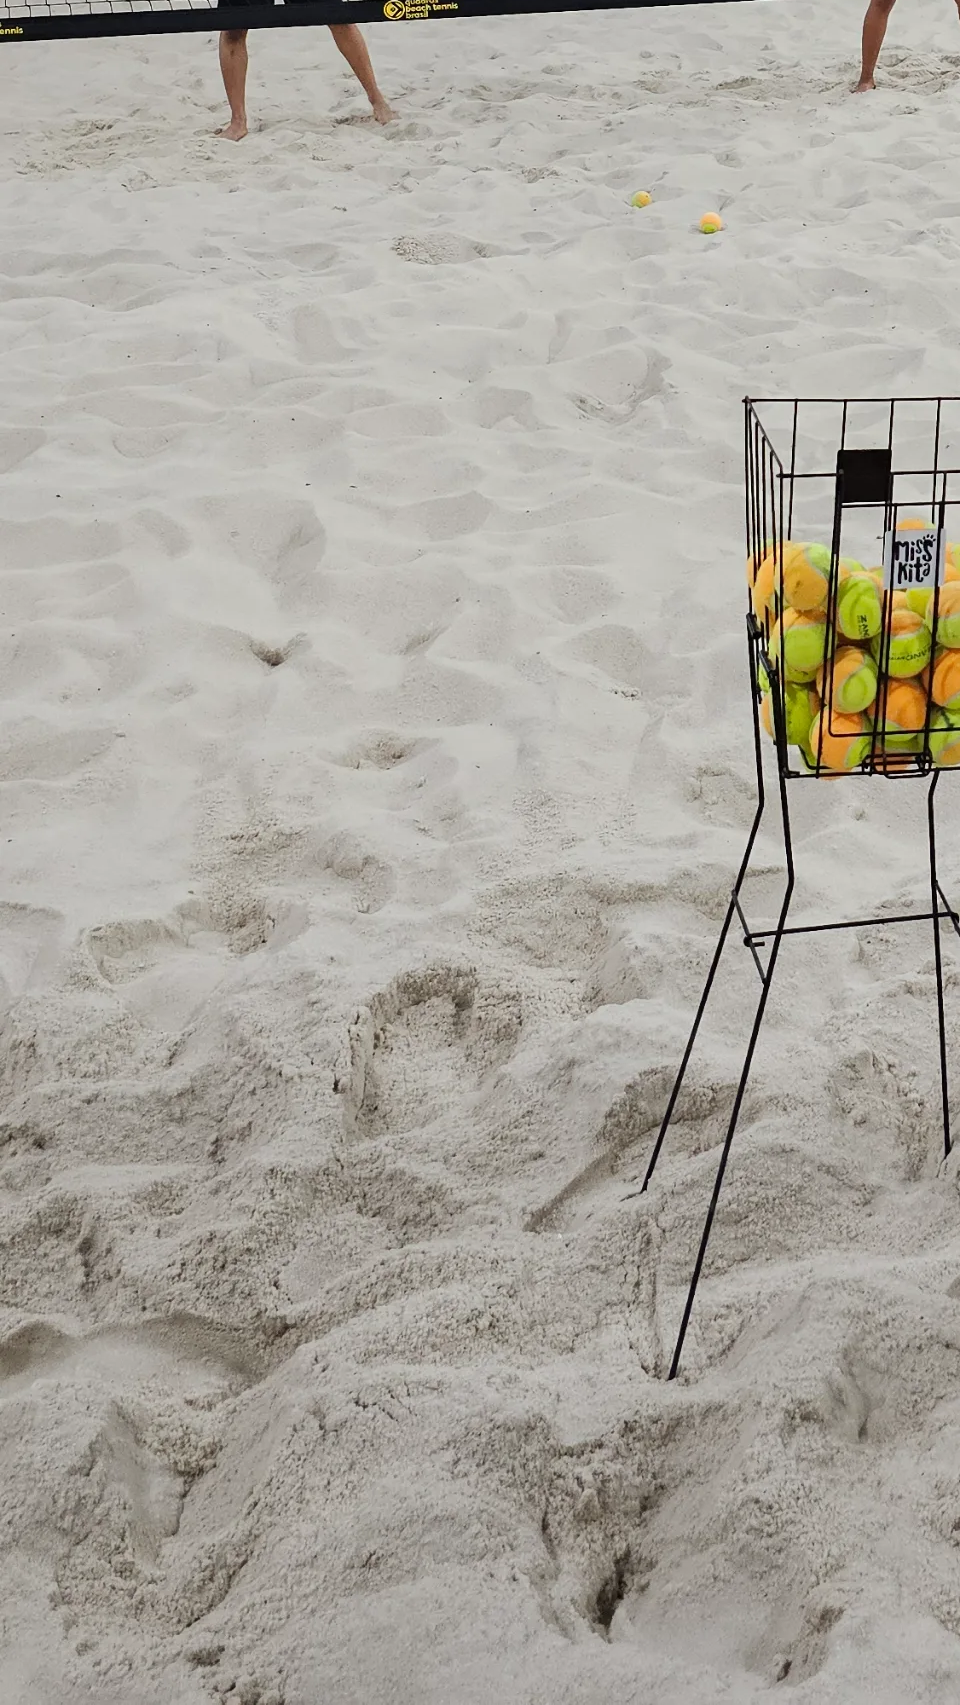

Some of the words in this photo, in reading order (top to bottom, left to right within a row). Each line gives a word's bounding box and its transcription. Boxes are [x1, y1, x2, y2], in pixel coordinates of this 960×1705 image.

[405, 4, 431, 12] beach
[433, 2, 459, 11] tennis
[405, 10, 429, 19] brasil
[0, 26, 24, 35] ennis
